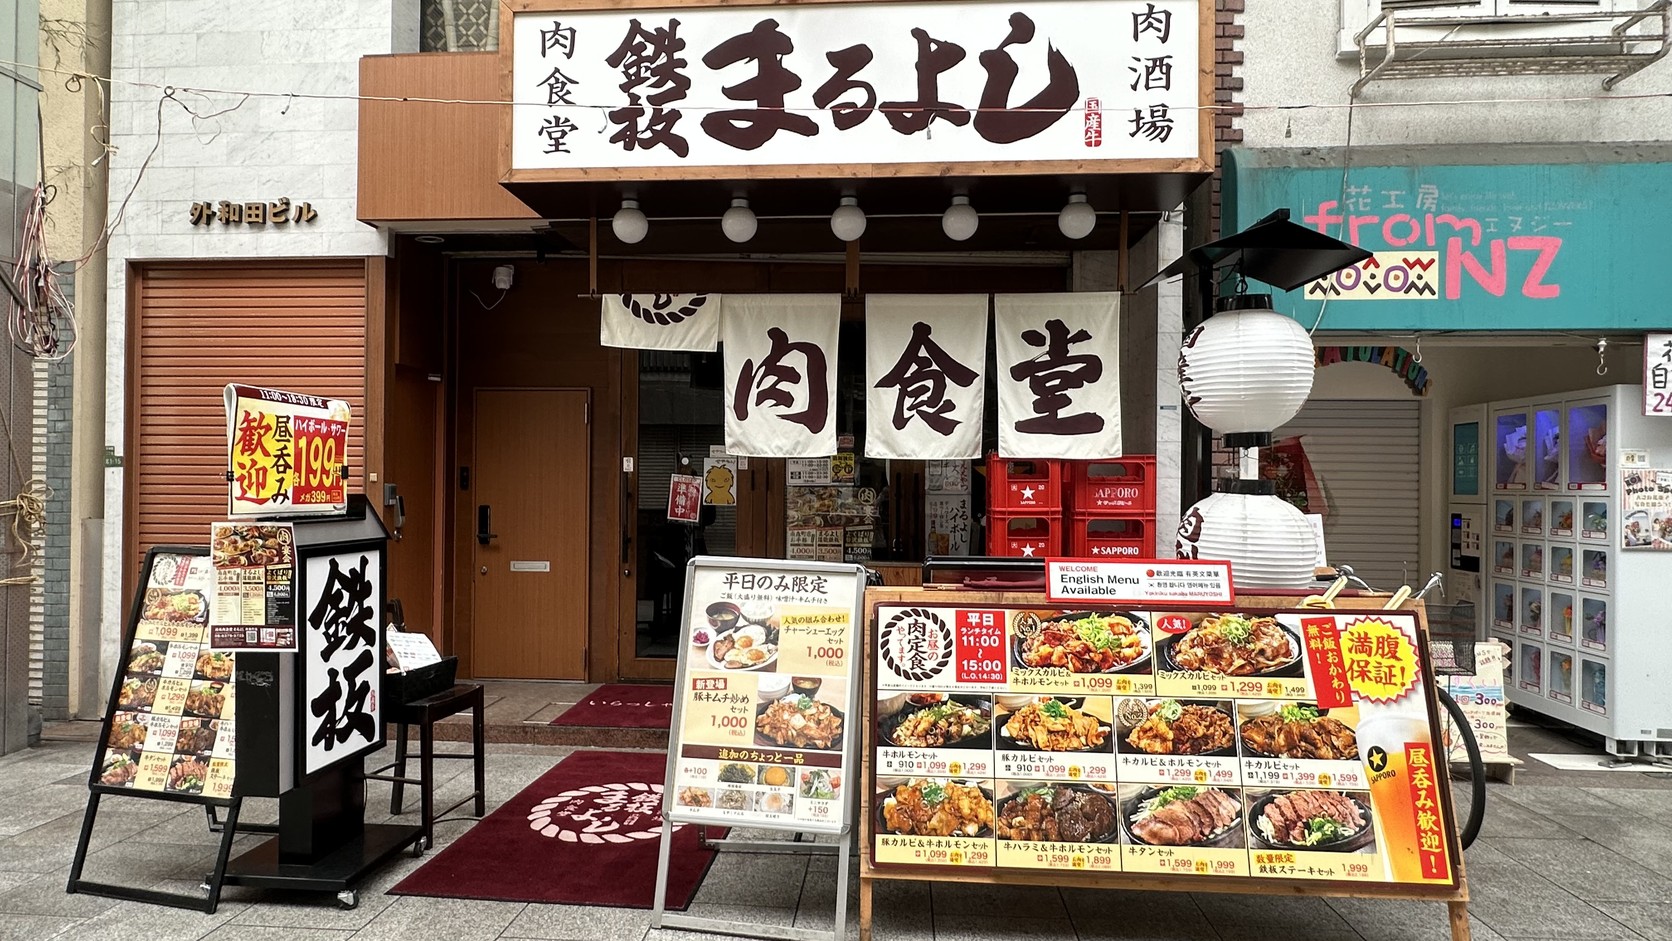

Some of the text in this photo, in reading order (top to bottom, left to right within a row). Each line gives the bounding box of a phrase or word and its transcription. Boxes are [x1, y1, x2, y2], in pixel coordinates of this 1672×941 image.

[1128, 3, 1174, 143] 肉酒場
[701, 11, 1080, 149] まるよし
[538, 21, 580, 156] 肉食堂
[1084, 97, 1102, 148] 国産牛
[1346, 185, 1439, 211] 花工房
[190, 197, 317, 226] 外和田ビル
[1304, 201, 1482, 248] from
[1446, 236, 1563, 300] NZ
[733, 320, 1104, 436] 肉食堂
[235, 410, 272, 505] 歓迎
[271, 414, 293, 504] 昼呑み
[960, 499, 968, 543] まるよし
[950, 507, 960, 551] ハイボール
[1101, 546, 1139, 555] SAPPORO
[1058, 565, 1098, 573] WELCOME
[723, 572, 828, 594] 平日のみ限定
[1061, 574, 1140, 585] English Menu
[1061, 585, 1117, 596] Available
[784, 614, 846, 624] 人気の組み合わせ!
[967, 613, 994, 626] 平日
[1161, 618, 1187, 630] 人気!
[784, 626, 846, 636] チャーシューエッグ
[961, 627, 1001, 635] ランチタイム
[907, 618, 928, 671] 肉定食
[927, 628, 940, 661] お昼の
[962, 636, 1000, 646] 11:00
[1306, 624, 1322, 664] 無料!
[1347, 631, 1403, 662] 満腹
[308, 554, 377, 753] 鉄板
[807, 646, 844, 660] 1,000
[962, 660, 1002, 671] 15:00
[1321, 622, 1345, 704] ご飯おかわり
[961, 672, 1003, 680] (L.O.14:30)
[1012, 667, 1071, 677] ミックスカルビ&
[1159, 670, 1226, 681] ミックスカルビセット
[1346, 658, 1406, 688] 保証!
[696, 679, 725, 689] 新登場
[1012, 677, 1069, 686] 牛ホルモンセット
[1081, 677, 1113, 689] 1,099
[1230, 681, 1263, 693] 1,299
[693, 692, 750, 704] 豚キムチ炒め
[711, 715, 748, 728] 1,000
[1474, 719, 1495, 729] 300
[718, 748, 805, 764] 追加のちょっと一品
[882, 749, 938, 760] 牛ホルモンセット
[1001, 753, 1054, 763] 豚カルビセット
[898, 760, 914, 768] 910
[923, 761, 947, 770] 1,099
[963, 762, 987, 771] 1,299
[1122, 756, 1222, 768] 牛カルビ&ホルモンセット
[1245, 760, 1300, 771] 牛カルビセット
[1016, 764, 1032, 772] 910
[1042, 765, 1066, 774] 1,099
[1082, 766, 1107, 775] 1,299
[1167, 769, 1192, 778] 1,299
[1208, 769, 1233, 779] 1,499
[1254, 771, 1280, 780] 1,199
[1290, 772, 1315, 781] 1,399
[1332, 773, 1358, 782] 1,599
[1370, 769, 1396, 784] SAPPORO
[808, 805, 829, 814] +150
[1408, 748, 1443, 874] 昼呑み歓迎!
[881, 838, 989, 850] 豚カルビ&牛ホルモンセット
[1003, 842, 1113, 855] 牛ハラミ&牛ホルモンセット
[923, 850, 947, 859] 1,099
[963, 850, 988, 860] 1,299
[1128, 846, 1175, 857] 牛タンセット
[1045, 854, 1070, 863] 1,599
[1086, 855, 1111, 865] 1,899
[1167, 858, 1192, 868] 1,599
[1256, 853, 1294, 864] 数量限定
[1210, 860, 1235, 870] 1,999
[1259, 864, 1335, 877] 鉄板ステーキセット
[1342, 863, 1368, 873] 1,999
